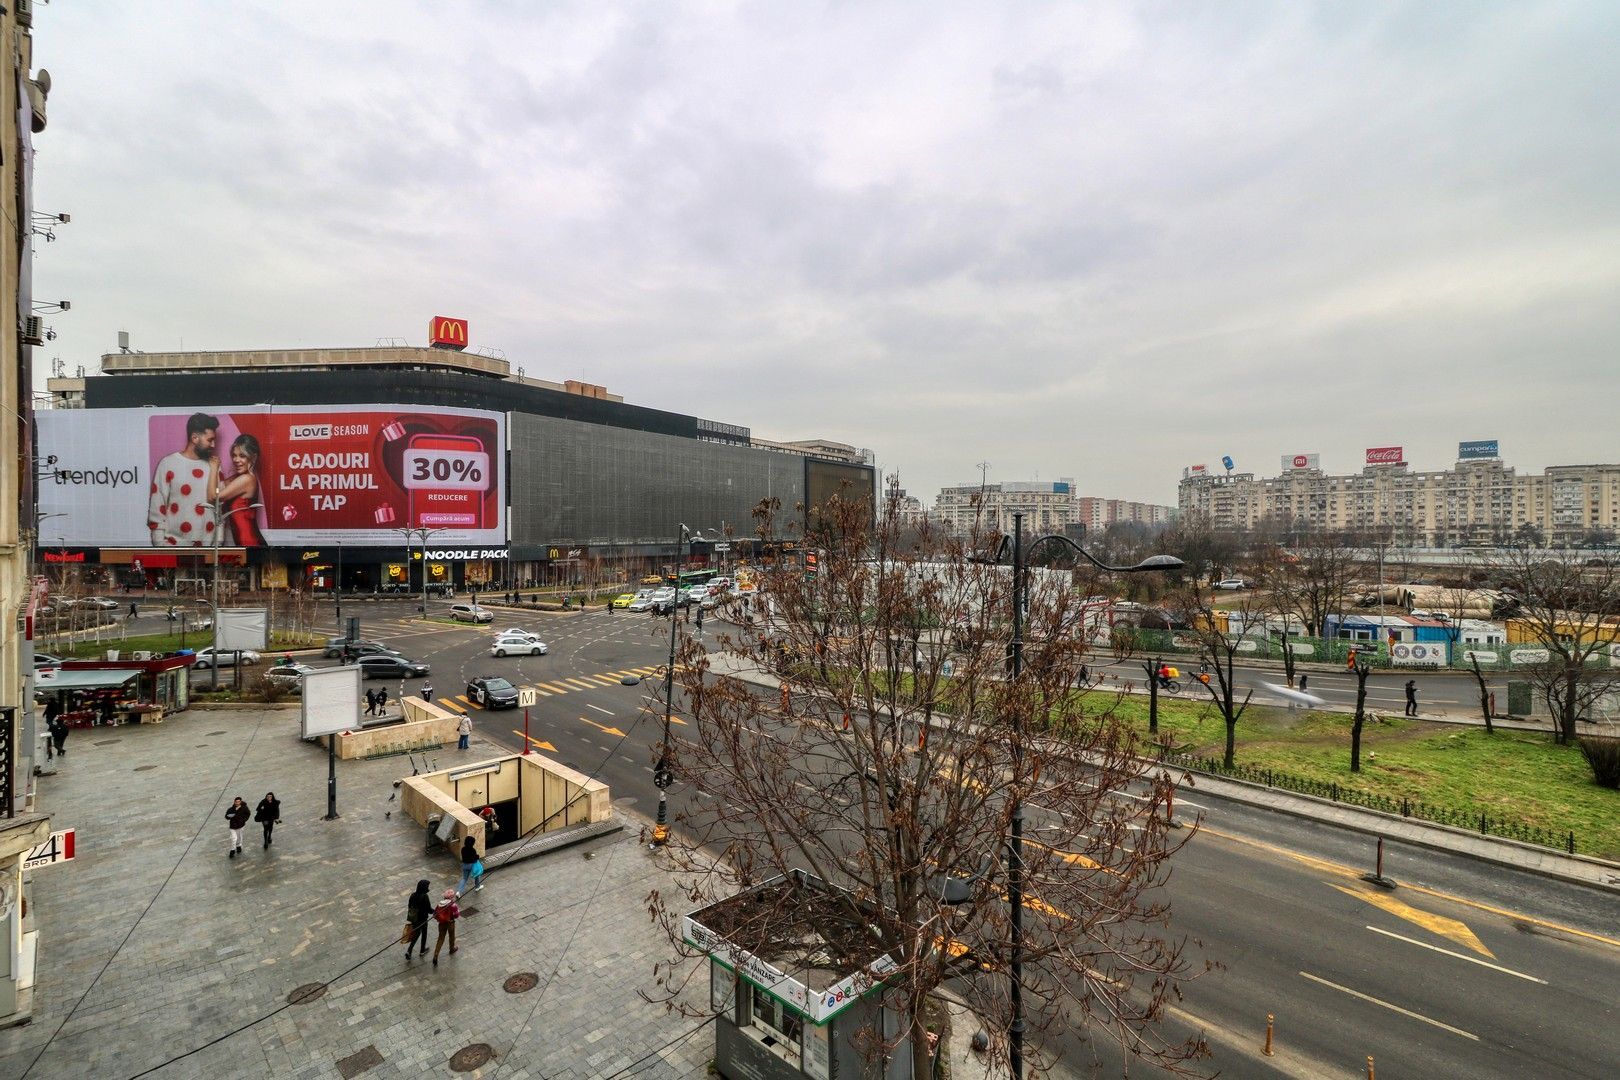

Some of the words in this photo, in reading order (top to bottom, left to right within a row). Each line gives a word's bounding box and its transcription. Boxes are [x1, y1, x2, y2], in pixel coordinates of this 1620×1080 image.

[294, 427, 329, 437] LOVE
[333, 424, 369, 436] SEASON
[288, 452, 369, 469] CADOURI
[412, 457, 482, 482] 30%
[280, 474, 304, 490] LA
[307, 473, 379, 490] PRIMUL
[310, 494, 347, 511] TAP
[424, 550, 479, 560] NOODLE
[480, 549, 509, 559] PACK
[521, 691, 533, 704] M
[23, 858, 48, 869] BRD
